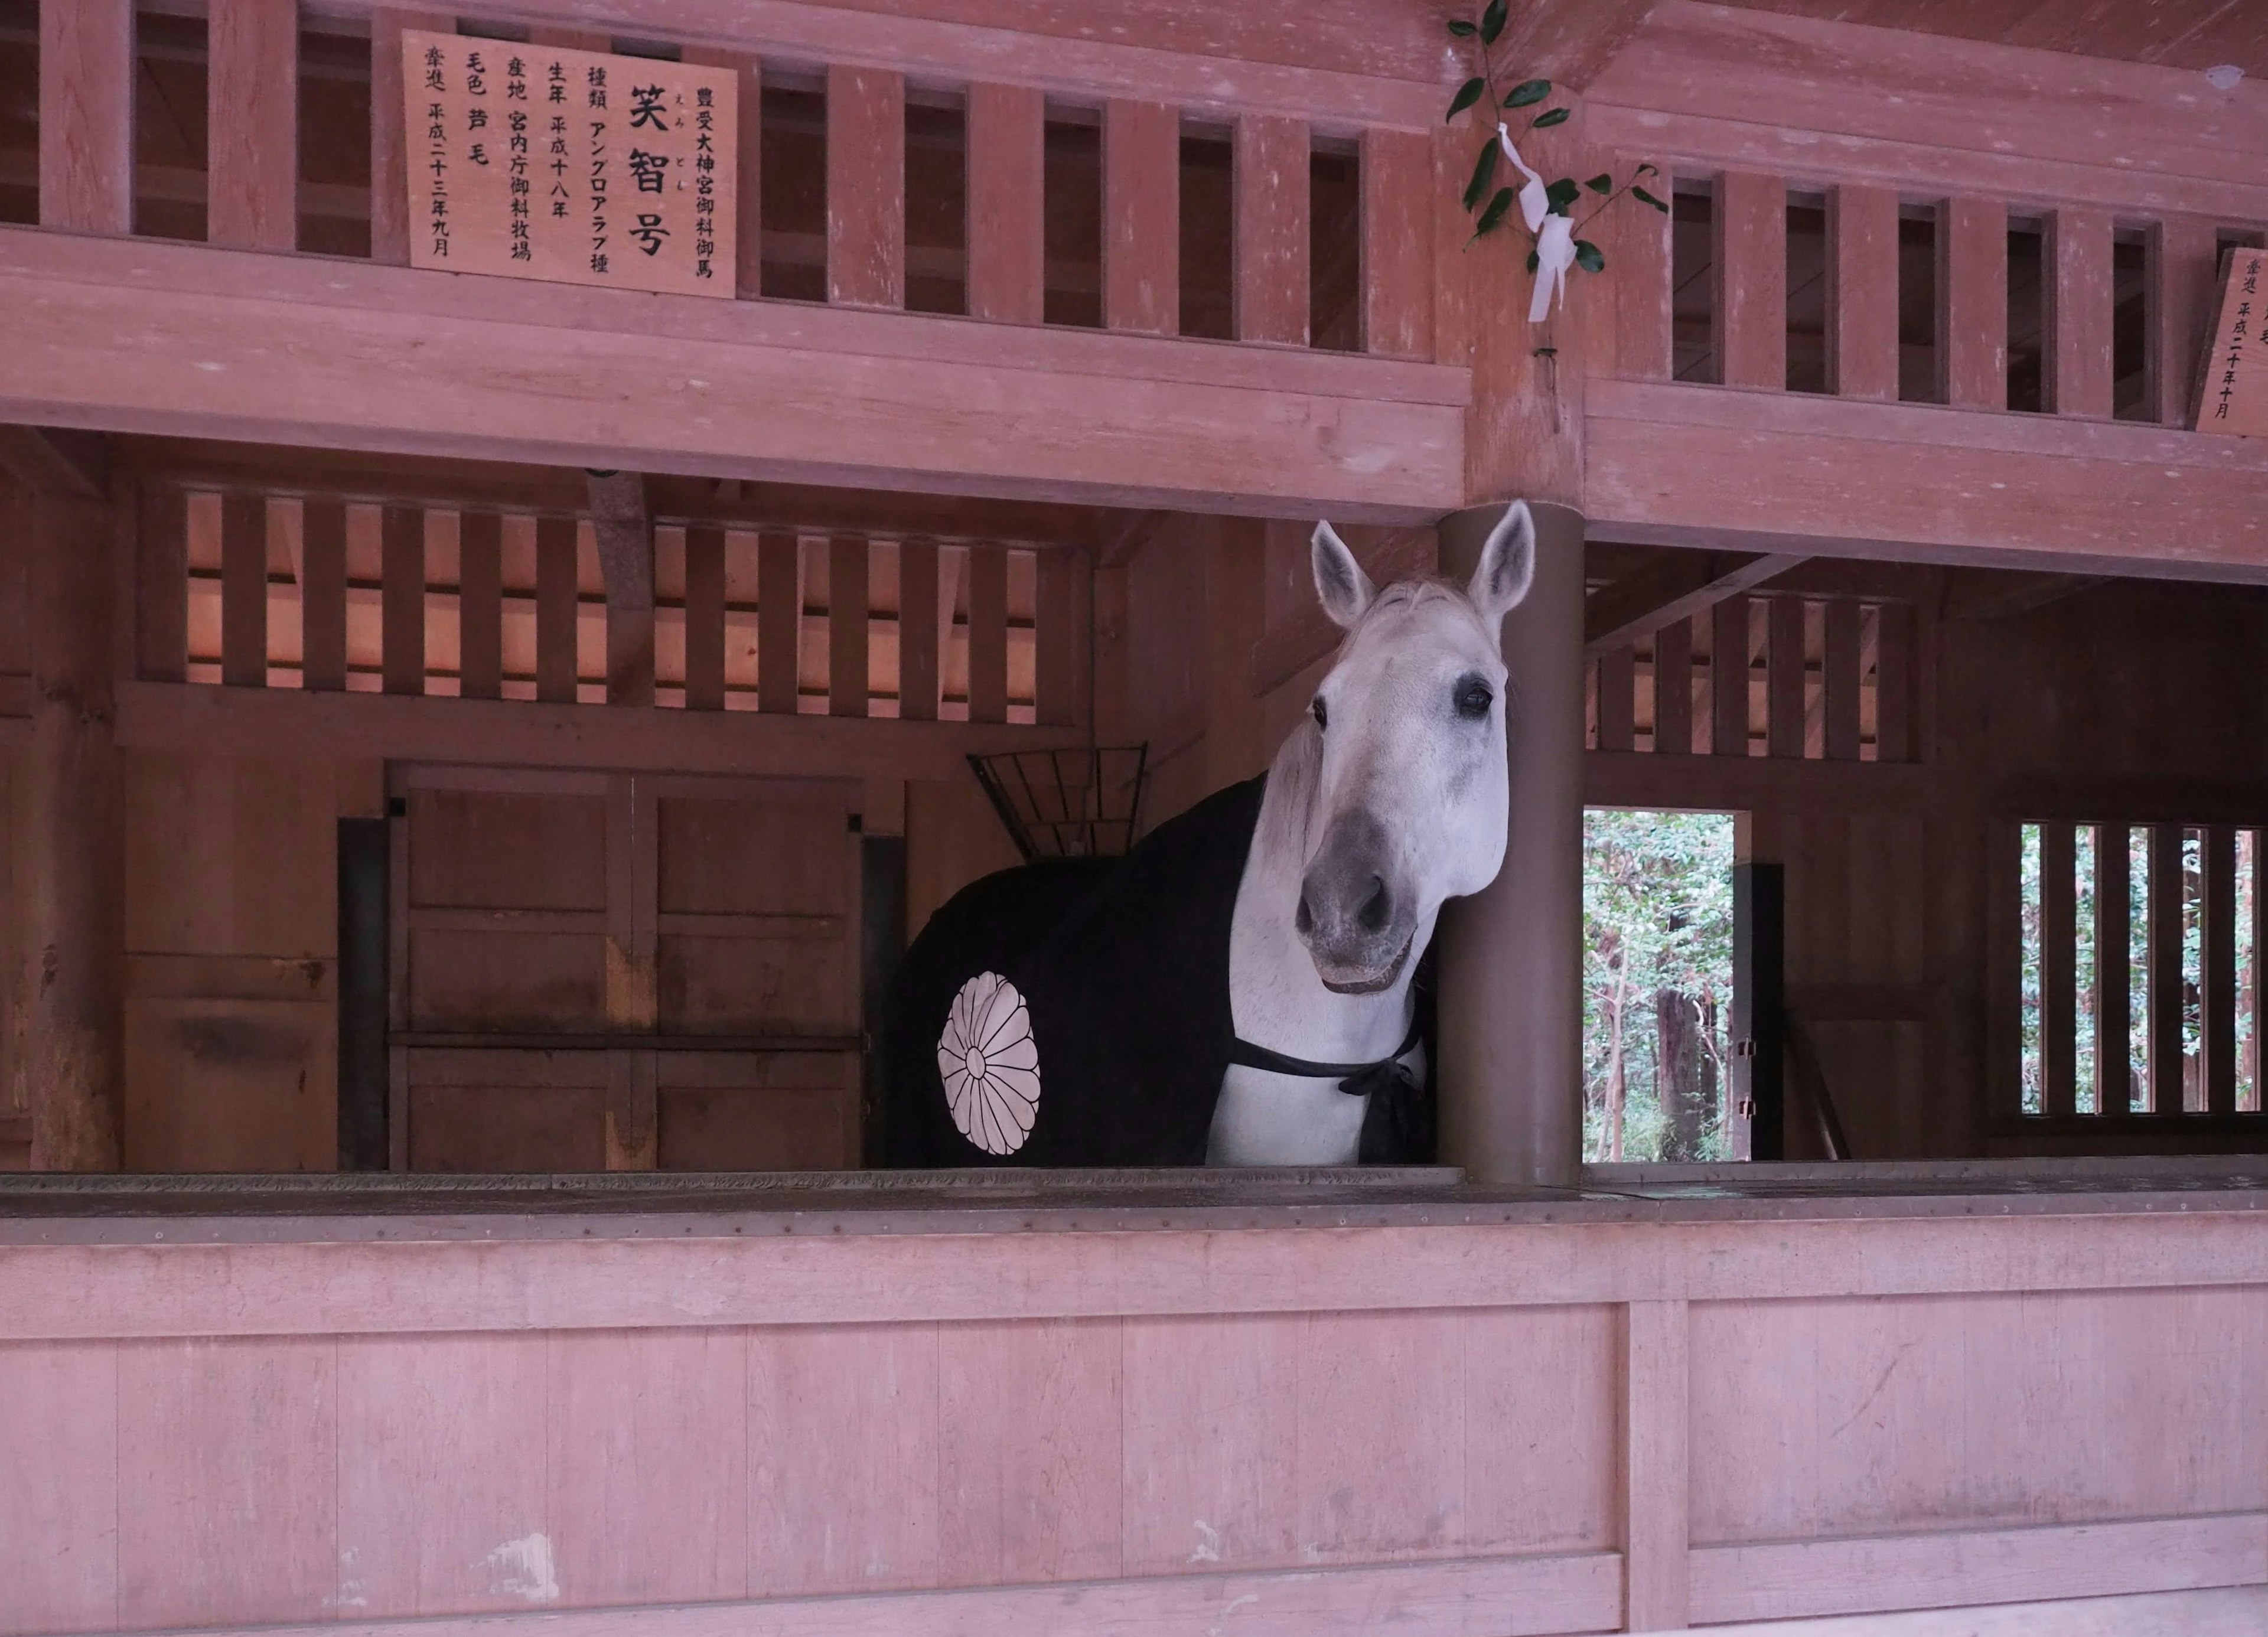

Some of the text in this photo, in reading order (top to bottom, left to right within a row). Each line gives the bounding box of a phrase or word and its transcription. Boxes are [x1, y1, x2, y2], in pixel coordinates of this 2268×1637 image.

[465, 51, 487, 96] 毛色
[548, 61, 569, 218] 生年 平成十八年
[428, 103, 449, 257] 平成二十三年九月
[507, 56, 532, 262] 産地 宮内庁御料牧場
[587, 66, 609, 273] 種類 アングロアラブ種
[628, 83, 671, 257] 笑智号
[2215, 302, 2251, 419] 平成二十年十月
